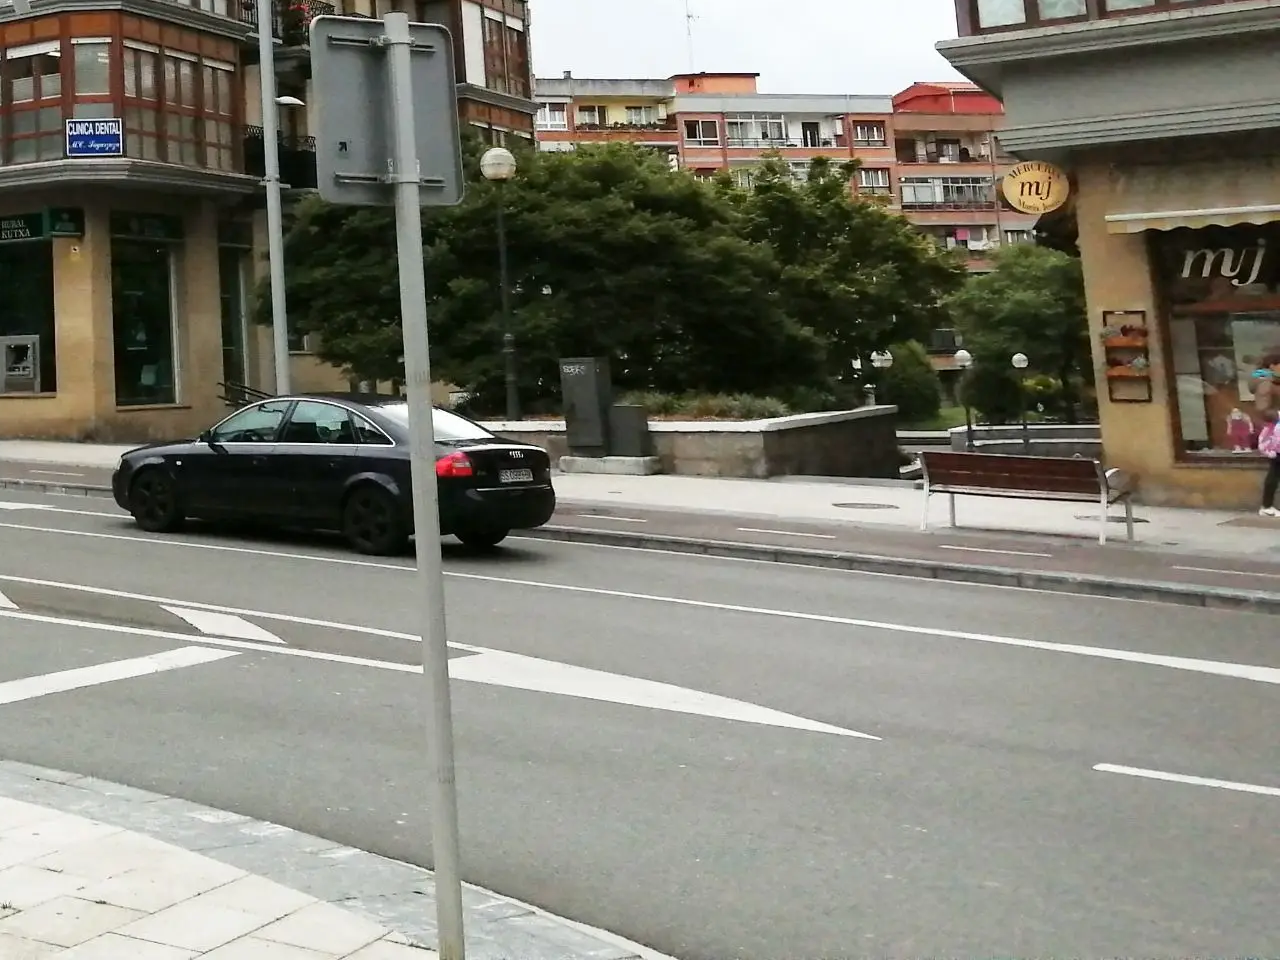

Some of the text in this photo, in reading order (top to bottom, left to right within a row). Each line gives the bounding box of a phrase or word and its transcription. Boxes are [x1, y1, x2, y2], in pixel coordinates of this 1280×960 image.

[95, 122, 120, 135] DENTAL
[1, 219, 26, 229] RURAL
[1, 228, 31, 239] KUTXA
